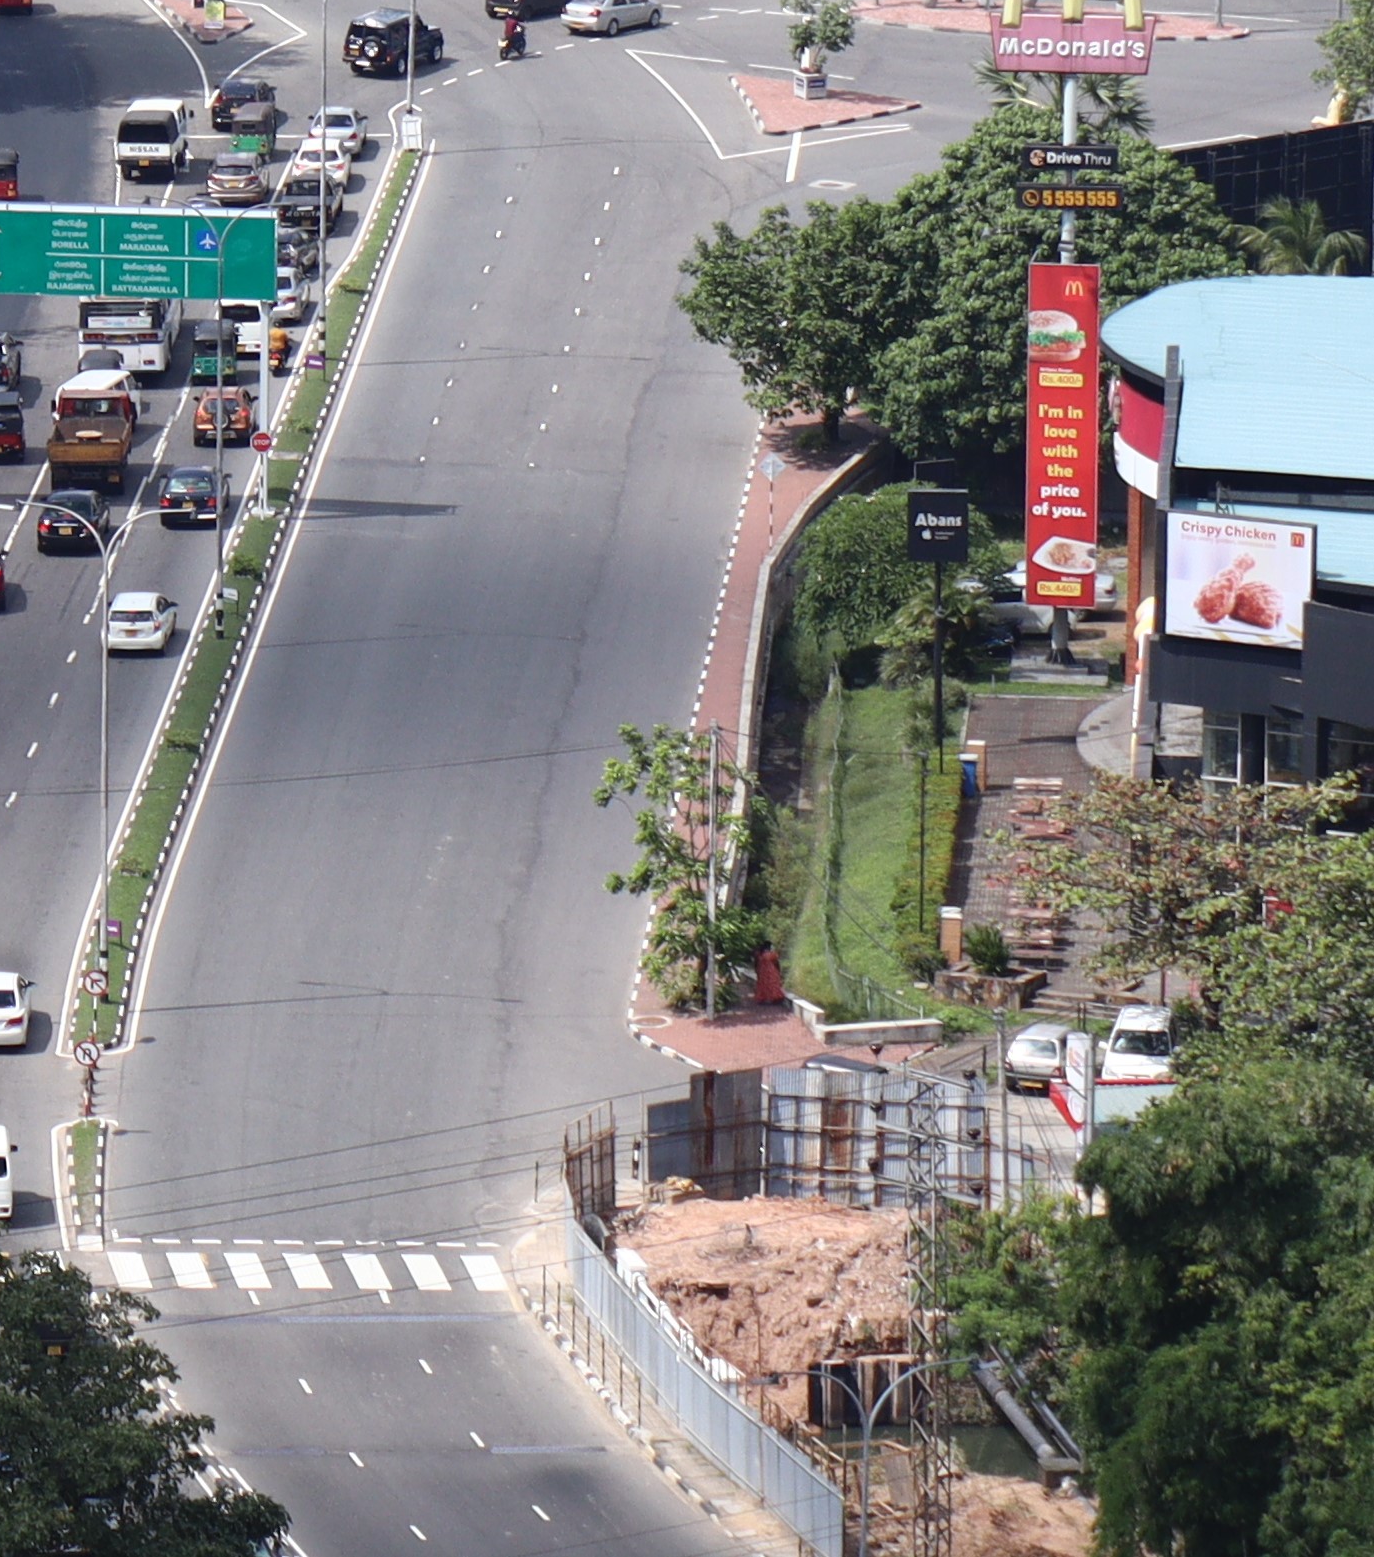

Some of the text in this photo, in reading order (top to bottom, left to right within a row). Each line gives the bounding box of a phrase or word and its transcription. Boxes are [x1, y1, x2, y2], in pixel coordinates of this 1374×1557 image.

[998, 37, 1145, 58] McDonald's
[129, 145, 160, 153] NISSAN
[1046, 152, 1112, 166] Drive Thru
[51, 240, 89, 249] BORELLA
[119, 243, 169, 252] MARADANA
[46, 281, 95, 291] RAJAGIRIYA
[111, 284, 178, 294] BATTARAMULLA
[1038, 404, 1083, 419] I'm in
[1044, 424, 1077, 439] love
[1042, 443, 1078, 458] with
[1047, 463, 1074, 477] the
[1040, 483, 1080, 500] price
[1031, 501, 1087, 519] of you.
[914, 512, 962, 527] Abans
[1181, 521, 1221, 538] Crispy
[1224, 525, 1277, 542] Chicken
